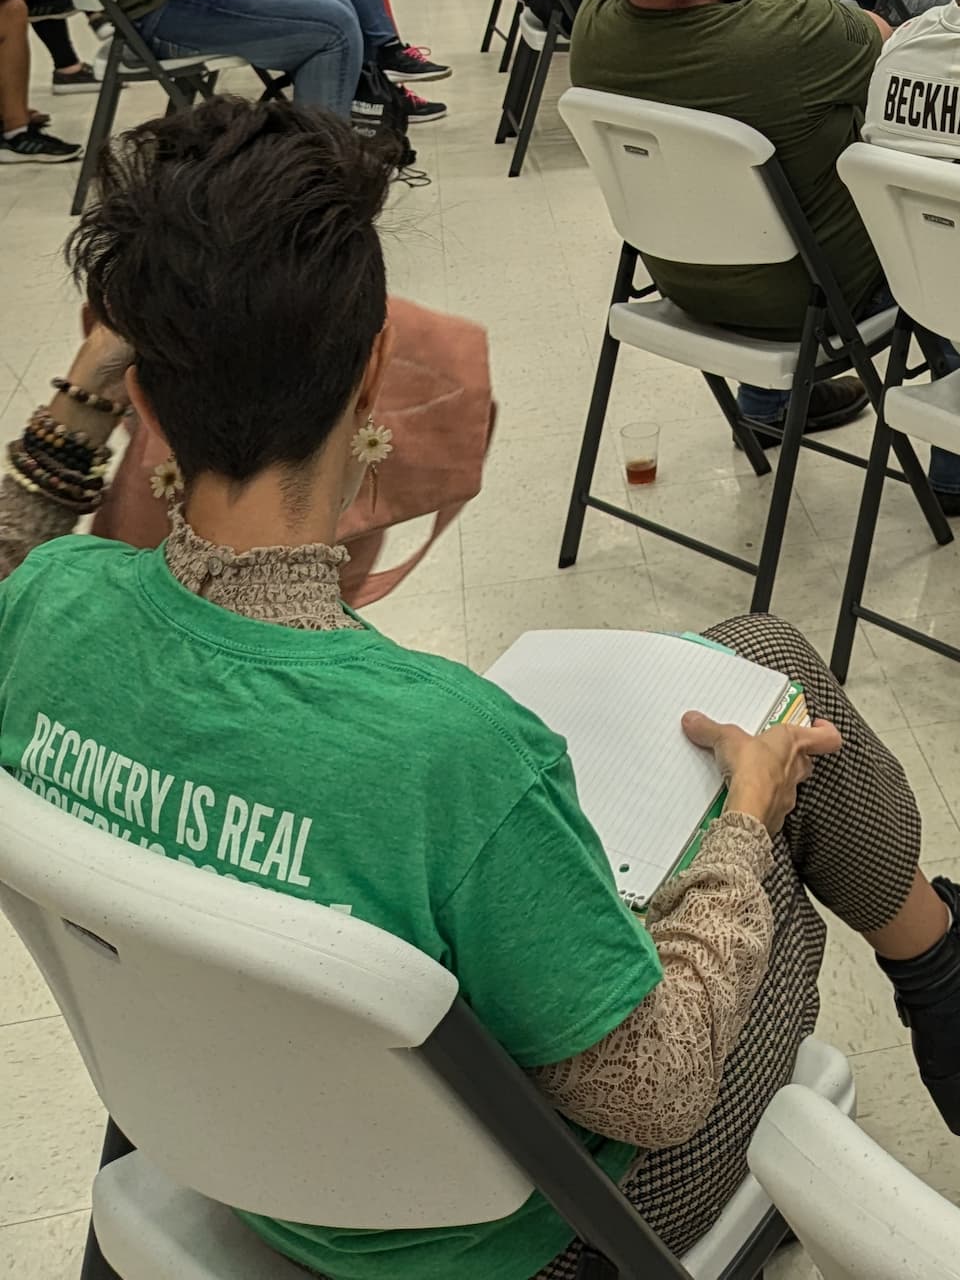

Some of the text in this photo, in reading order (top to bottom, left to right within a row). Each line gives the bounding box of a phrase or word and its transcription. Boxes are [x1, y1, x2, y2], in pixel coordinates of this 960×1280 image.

[20, 711, 176, 835] RECOVERY
[176, 780, 216, 852] IS
[216, 794, 313, 888] REAL
